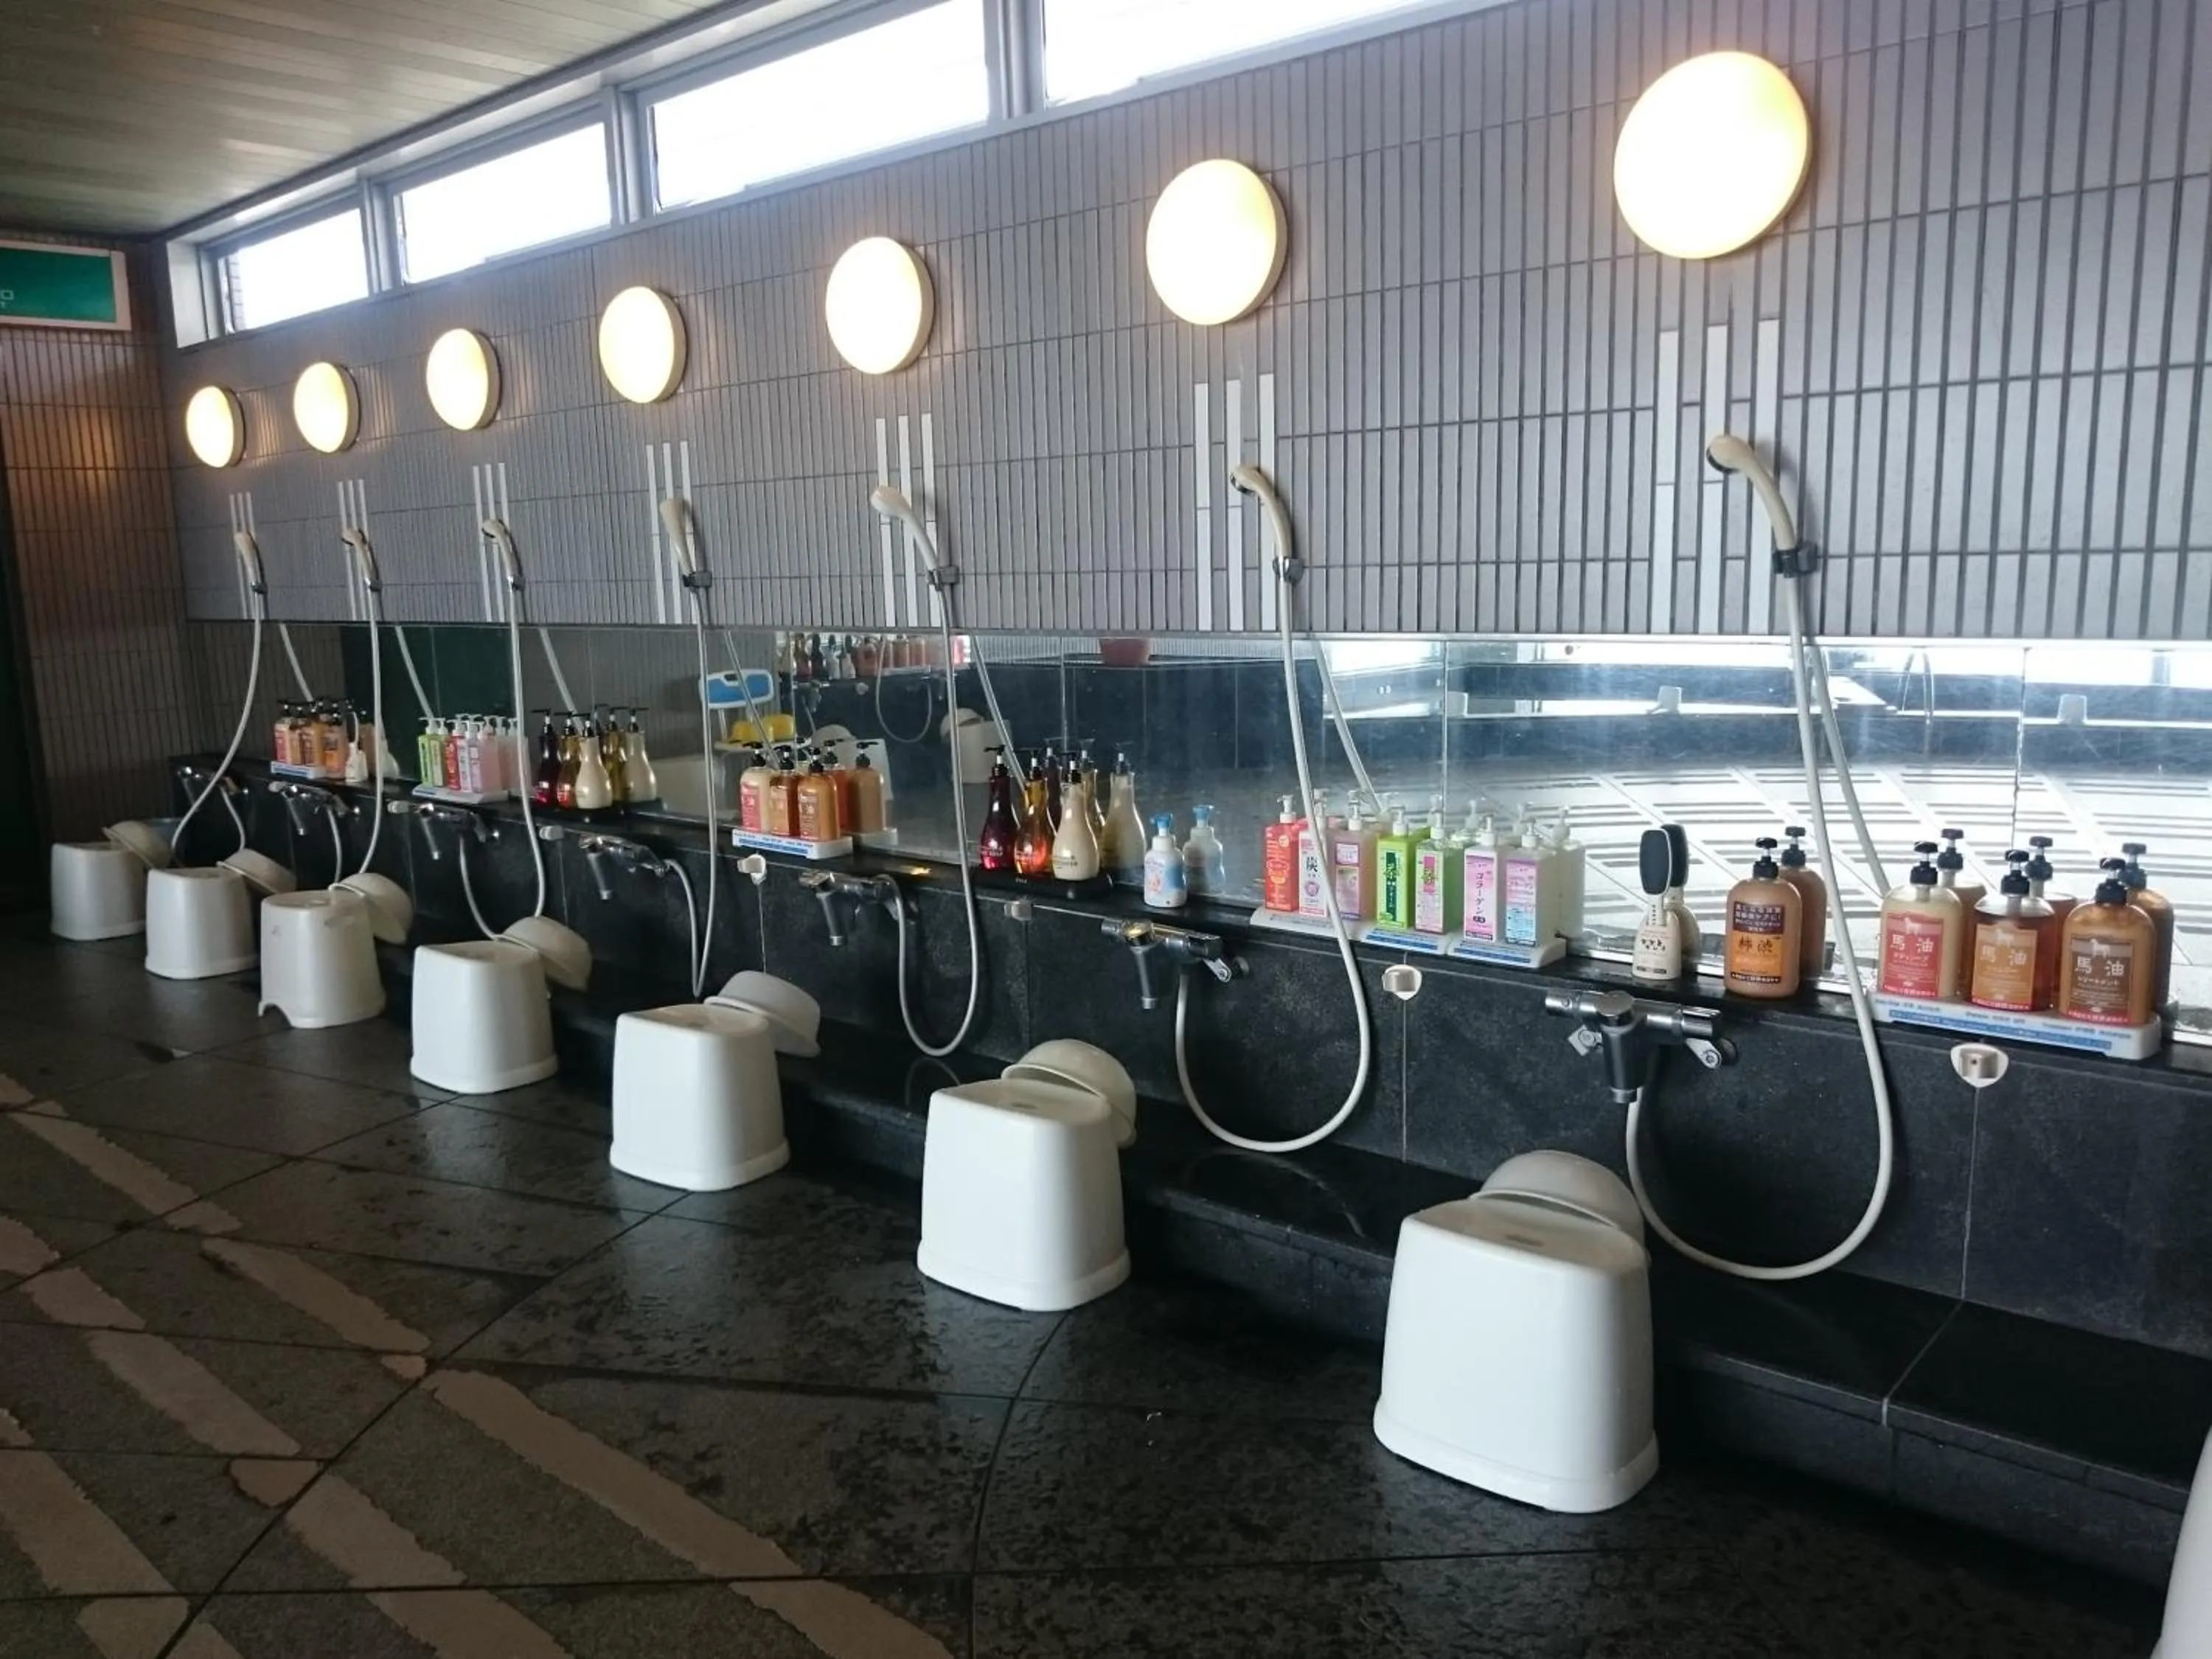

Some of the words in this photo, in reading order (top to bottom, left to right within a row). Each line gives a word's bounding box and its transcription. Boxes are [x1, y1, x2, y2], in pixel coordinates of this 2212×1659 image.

[1475, 872, 1484, 915] コラーゲン
[1890, 933, 1934, 953] 馬油
[1980, 945, 2028, 966] 馬油
[2074, 956, 2125, 977] 馬油
